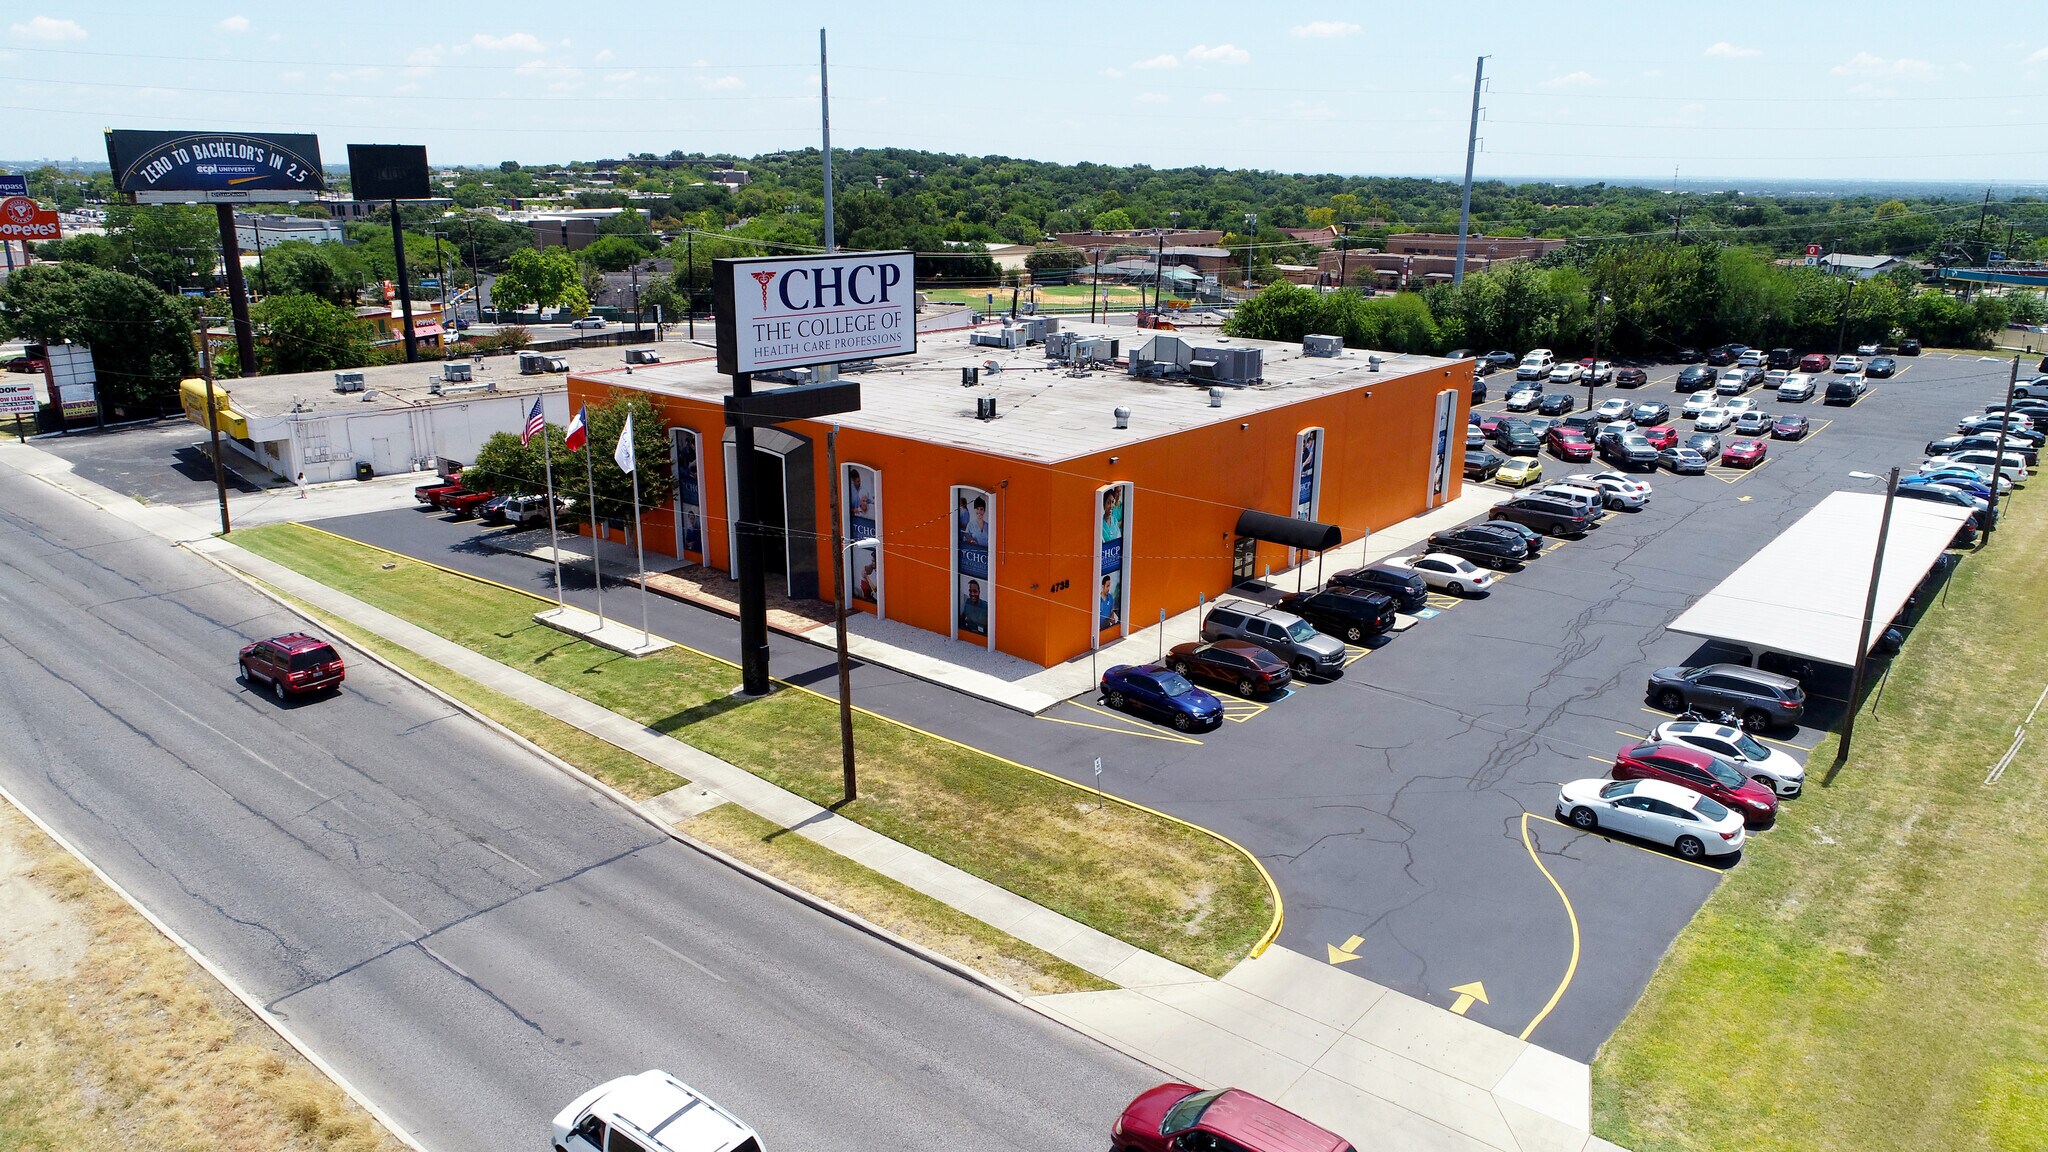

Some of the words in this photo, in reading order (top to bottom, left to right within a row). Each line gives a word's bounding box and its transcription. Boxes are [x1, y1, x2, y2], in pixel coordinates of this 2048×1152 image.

[140, 156, 172, 184] ZERO
[171, 148, 190, 166] TO
[192, 142, 264, 163] BACHELOR'S
[269, 153, 284, 170] IN
[286, 163, 309, 183] 2.5
[779, 263, 901, 311] CHCP
[752, 321, 792, 342] THE
[797, 314, 876, 338] COLLEGE
[881, 311, 902, 329] OF
[754, 344, 799, 358] HEALTH
[803, 339, 831, 352] CARE
[834, 332, 902, 350] PROFESSIONS
[858, 524, 876, 537] CHC
[966, 551, 987, 564] CHC
[1050, 579, 1070, 593] 4738
